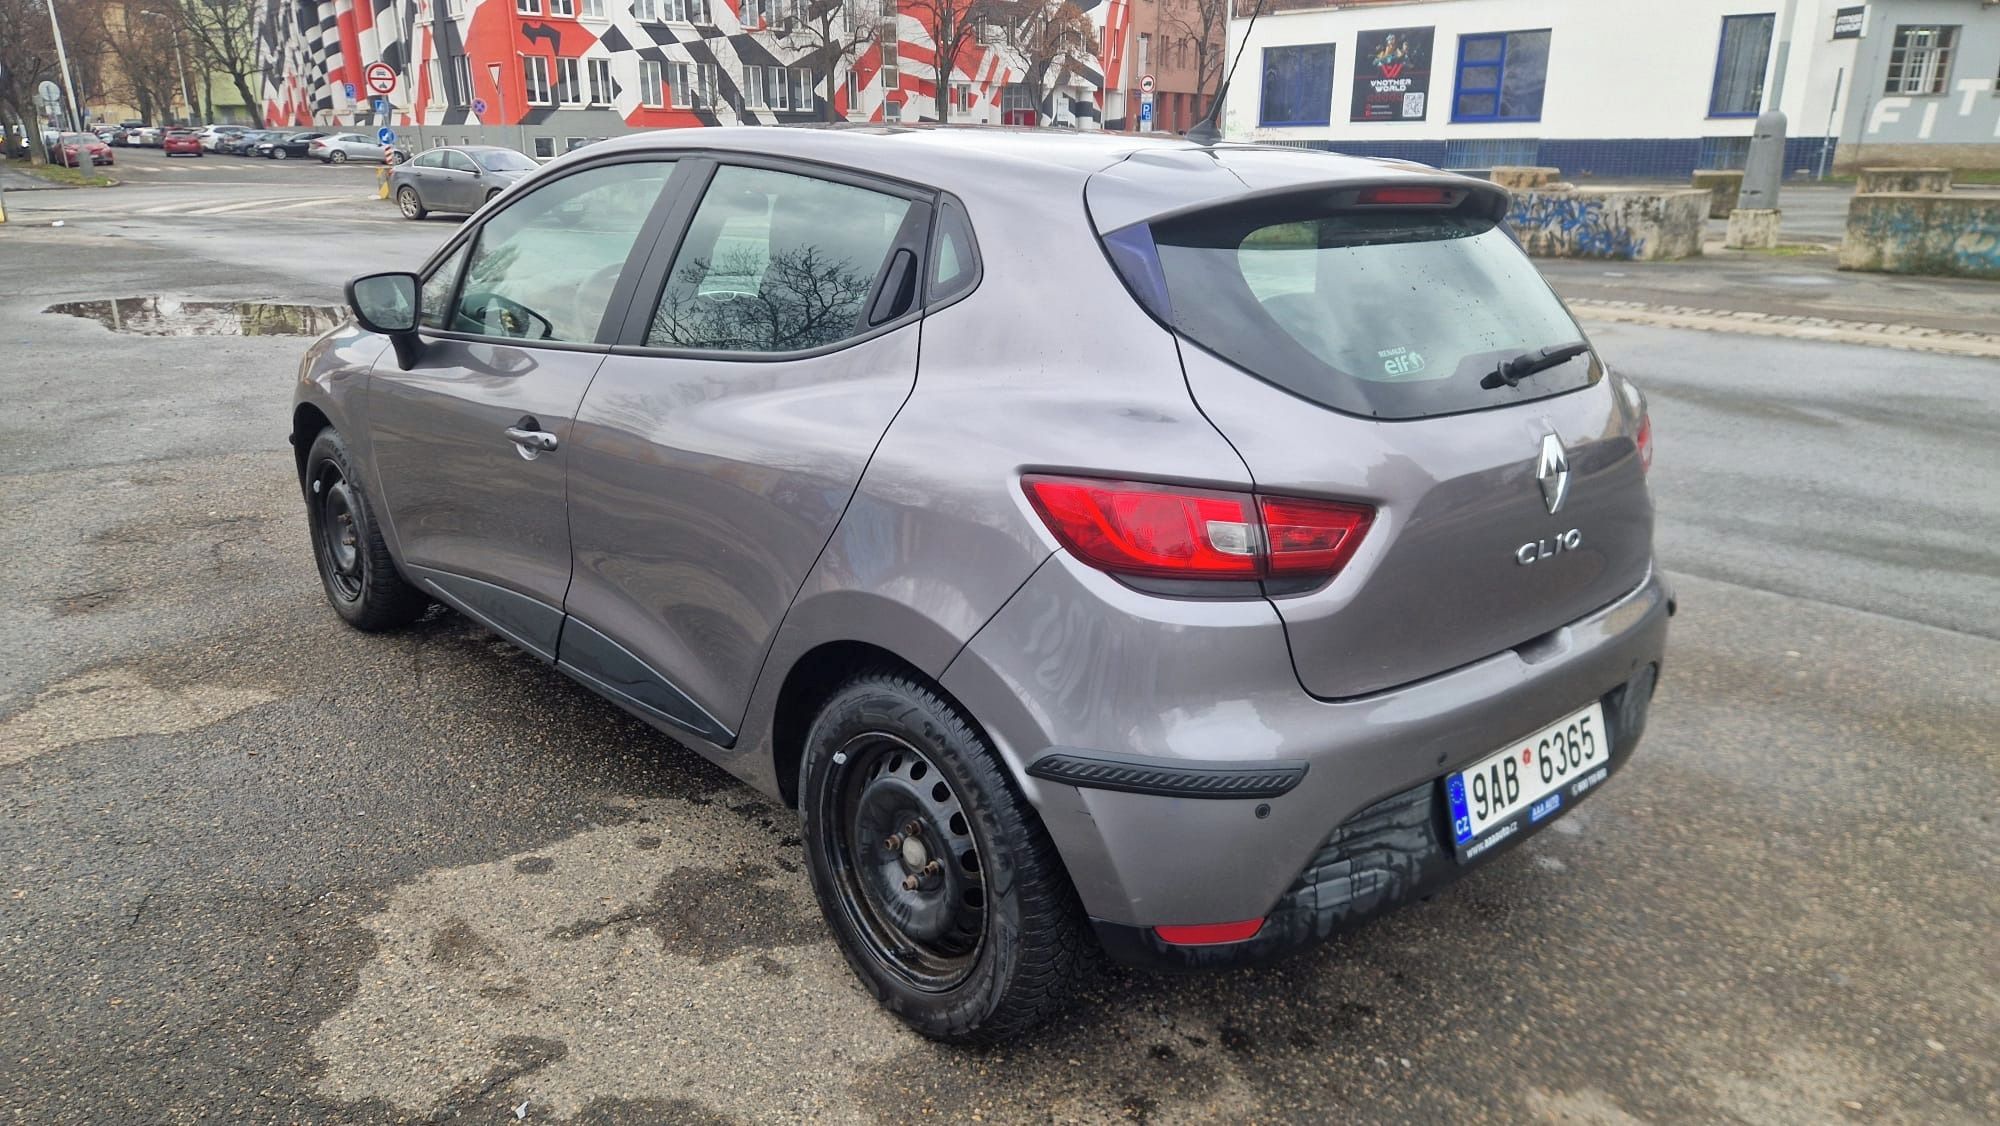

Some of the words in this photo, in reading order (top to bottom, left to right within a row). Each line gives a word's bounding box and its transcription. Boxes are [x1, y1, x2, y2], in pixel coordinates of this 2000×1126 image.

[1867, 78, 2000, 140] FIT
[1384, 354, 1409, 374] elf
[1515, 528, 1582, 566] CLIO
[1473, 756, 1520, 820] 9AB
[1538, 716, 1595, 784] 6365
[1456, 815, 1470, 835] CZ
